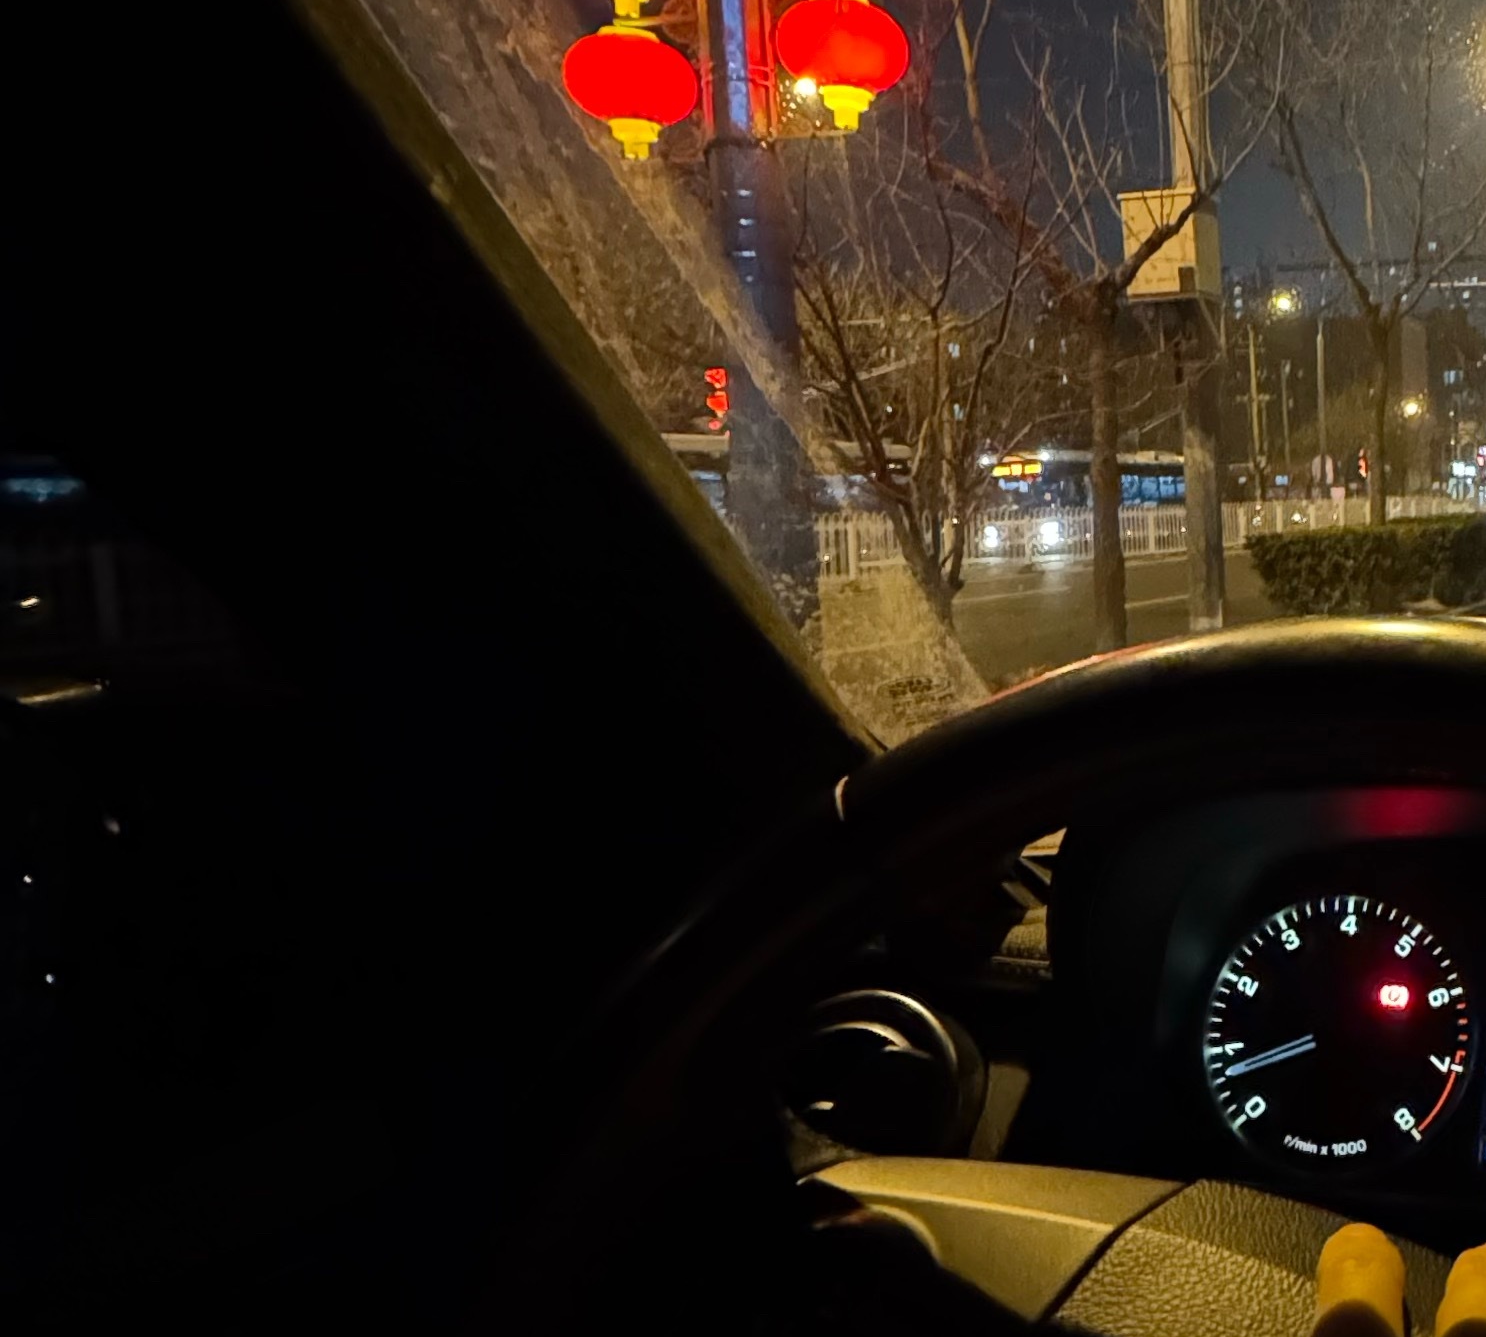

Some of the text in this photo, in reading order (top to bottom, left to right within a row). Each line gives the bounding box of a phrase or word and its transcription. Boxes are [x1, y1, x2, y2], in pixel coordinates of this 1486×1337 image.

[1340, 915, 1357, 936] 4
[1281, 929, 1300, 951] 3
[1394, 934, 1416, 958] 5
[1237, 976, 1259, 997] 2
[1427, 988, 1450, 1008] 6
[1225, 1041, 1244, 1056] 1
[1429, 1054, 1450, 1074] 7
[1244, 1095, 1266, 1119] 0
[1393, 1107, 1416, 1130] 8
[1283, 1134, 1317, 1155] r/min
[1332, 1139, 1367, 1156] 1000
